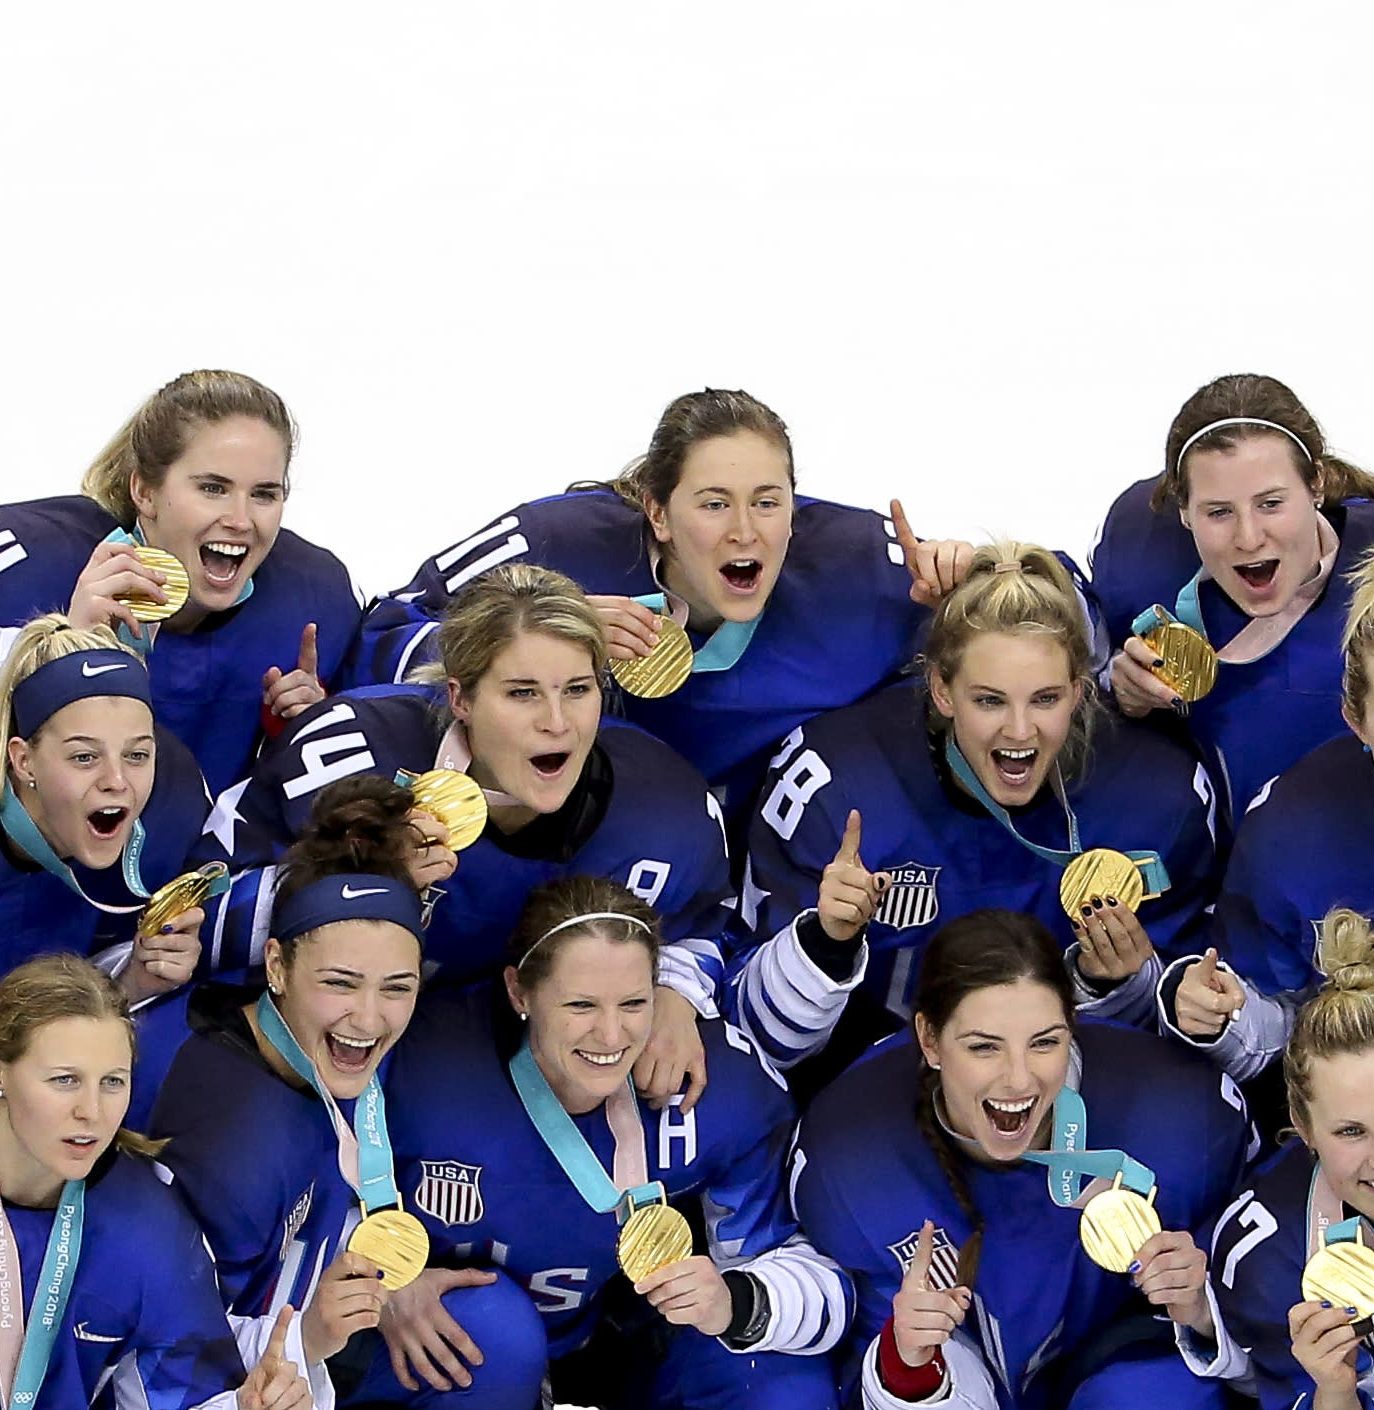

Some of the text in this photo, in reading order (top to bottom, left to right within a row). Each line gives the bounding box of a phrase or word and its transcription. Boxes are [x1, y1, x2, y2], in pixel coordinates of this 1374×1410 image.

[436, 514, 531, 595] 11
[282, 702, 377, 800] 14
[891, 869, 928, 884] USA
[430, 1164, 471, 1185] USA
[42, 1204, 76, 1326] PyeongChang 2018
